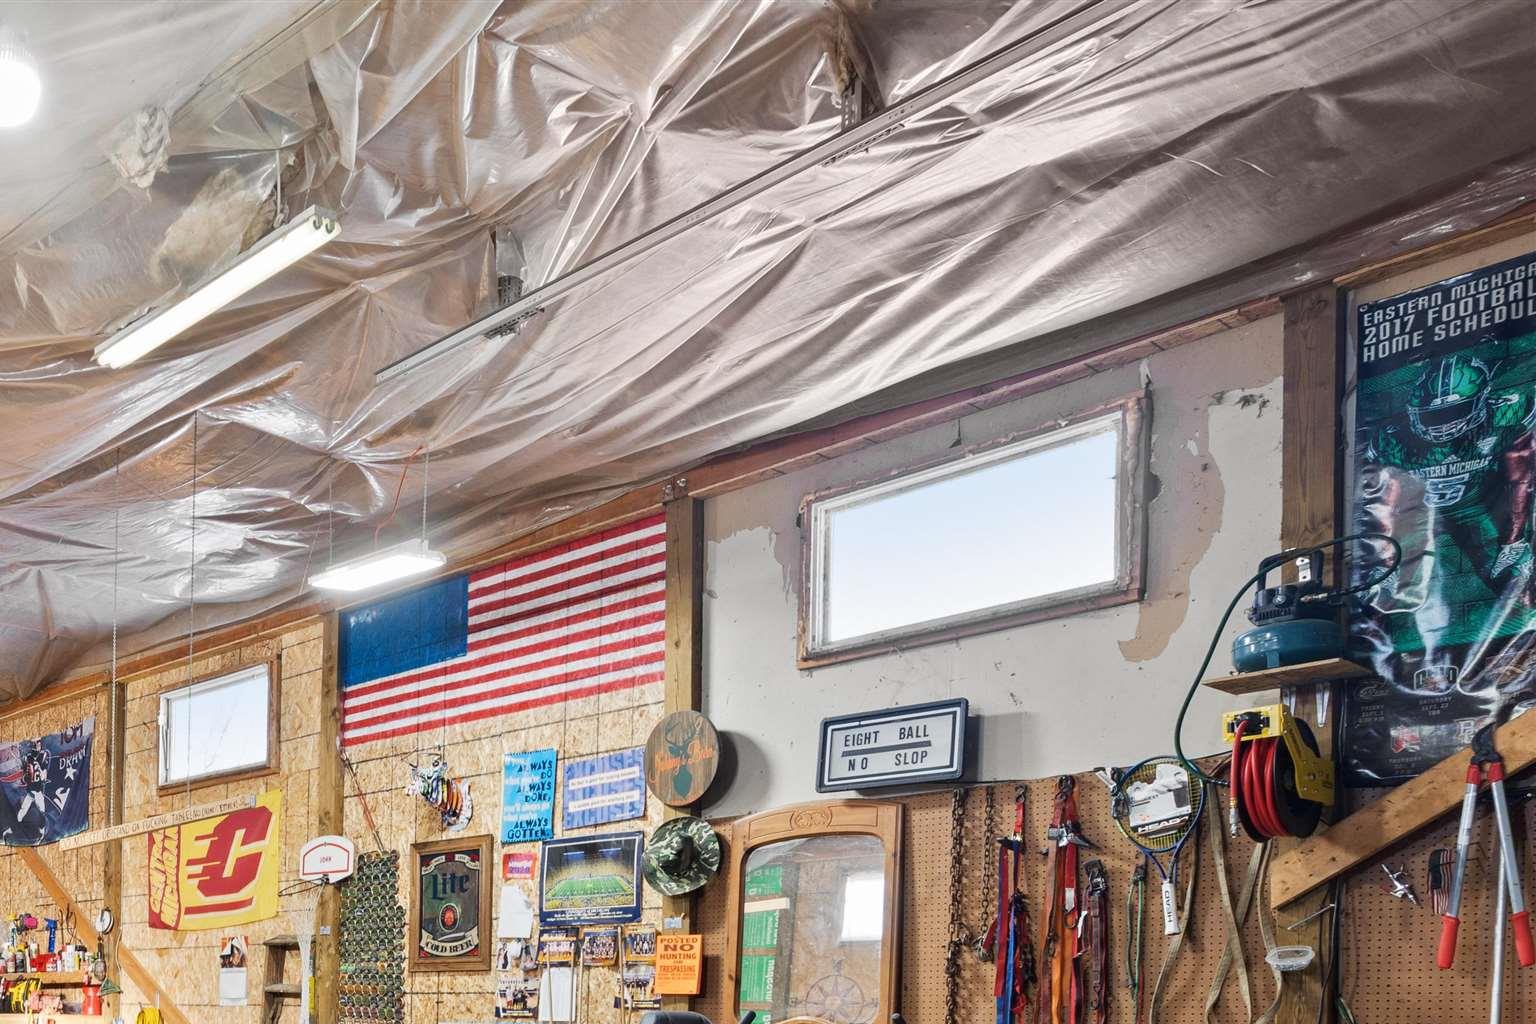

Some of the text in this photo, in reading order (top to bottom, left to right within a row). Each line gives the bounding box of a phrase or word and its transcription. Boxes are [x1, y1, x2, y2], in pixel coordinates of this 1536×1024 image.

[1363, 291, 1442, 327] EASTERN
[1364, 314, 1415, 346] 2017
[1363, 329, 1424, 363] HOME
[844, 724, 929, 747] EIGHT BALL
[517, 760, 553, 773] ALWAYS
[847, 750, 928, 772] NO SLOP
[540, 770, 553, 780] DO
[517, 781, 552, 793] ALWAYS
[514, 818, 549, 830] ALWAYS
[1137, 818, 1180, 833] HEAD
[431, 873, 470, 901] Lite
[1165, 890, 1173, 923] HEAD
[426, 939, 474, 954] COLD BEER
[663, 943, 694, 952] NO
